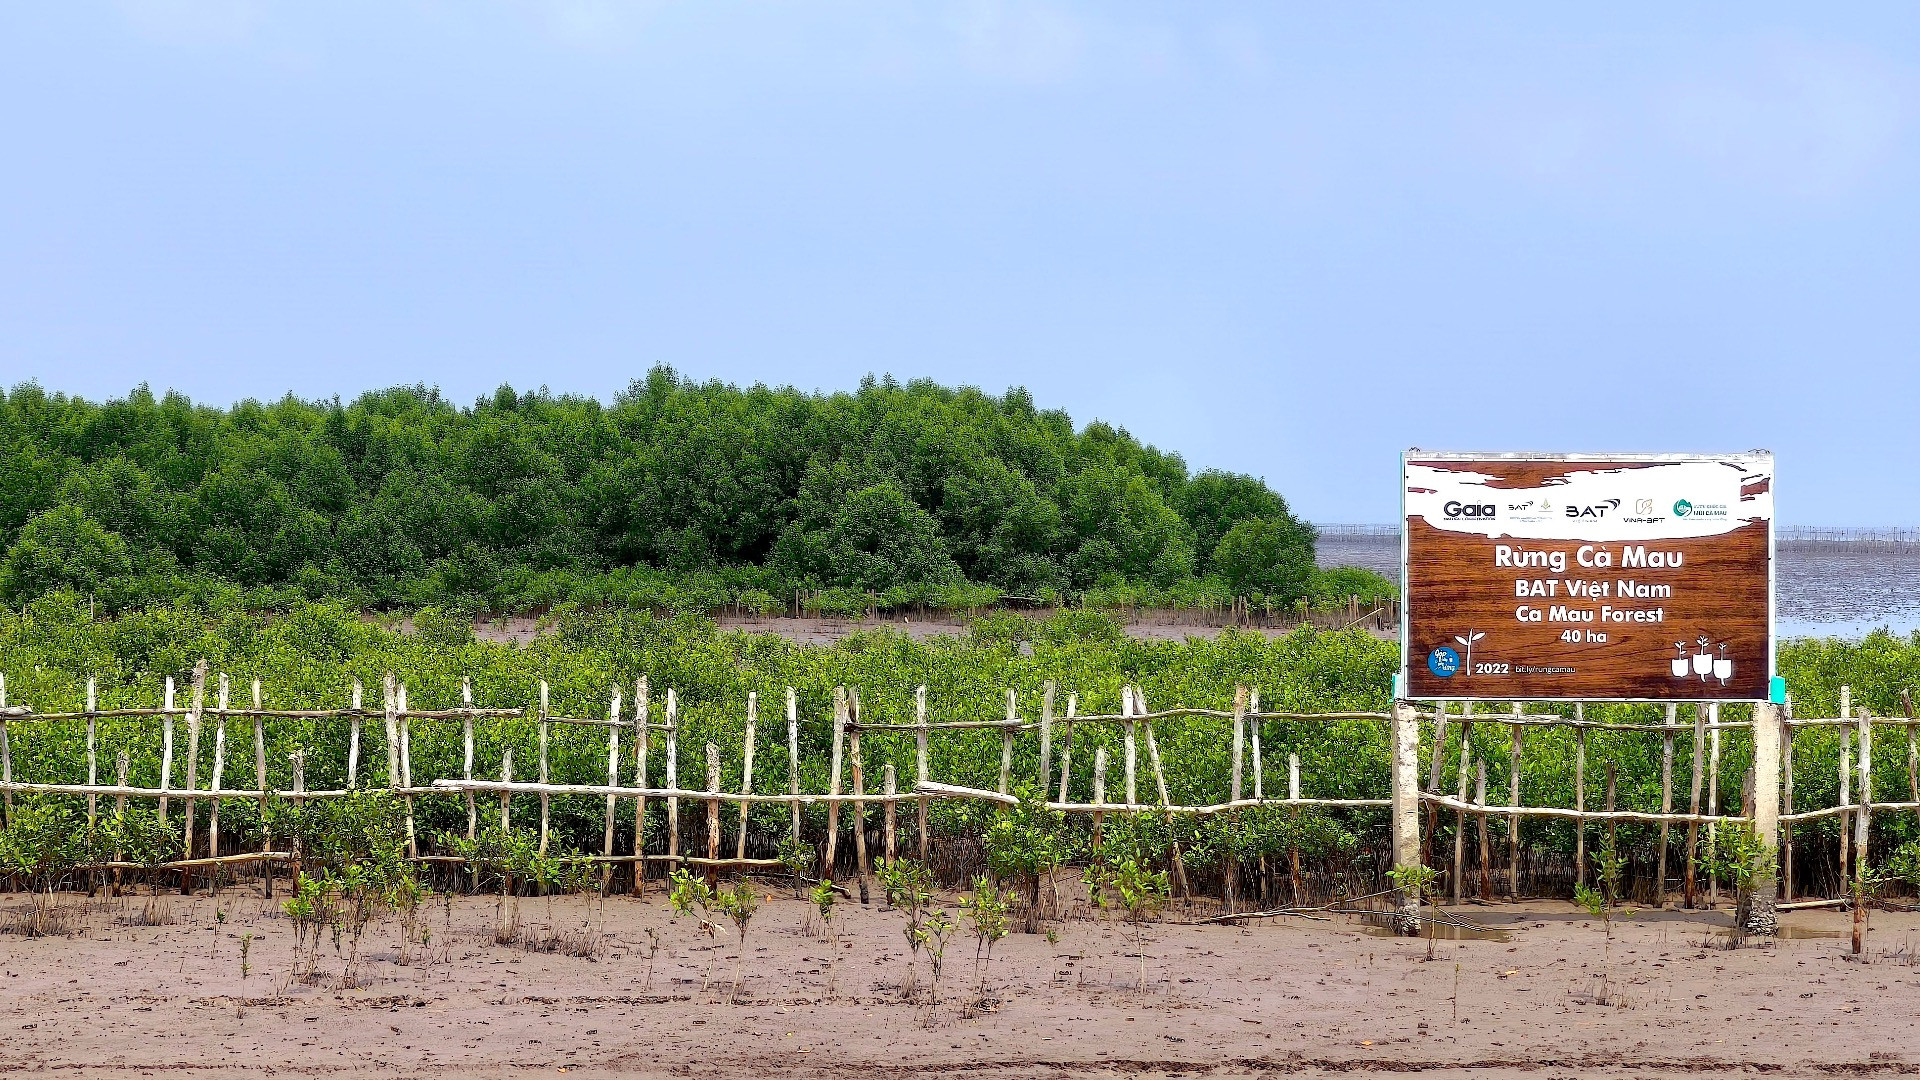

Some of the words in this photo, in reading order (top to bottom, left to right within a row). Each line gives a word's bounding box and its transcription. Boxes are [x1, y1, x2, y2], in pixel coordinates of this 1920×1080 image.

[1443, 500, 1496, 517] Gaia
[1565, 505, 1609, 518] BAT
[1495, 545, 1566, 573] Rừng
[1576, 545, 1612, 568] Cà
[1621, 545, 1683, 568] Mau
[1515, 579, 1559, 597] BAT
[1565, 579, 1610, 601] Việt
[1617, 579, 1672, 598] Nam
[1515, 606, 1542, 622] Ca
[1548, 605, 1594, 622] Mau
[1601, 605, 1664, 622] Forest
[1560, 630, 1581, 643] 40
[1586, 630, 1607, 643] ha
[1475, 663, 1509, 674] 2022
[1515, 665, 1576, 674] bit.ly/rungcamau
